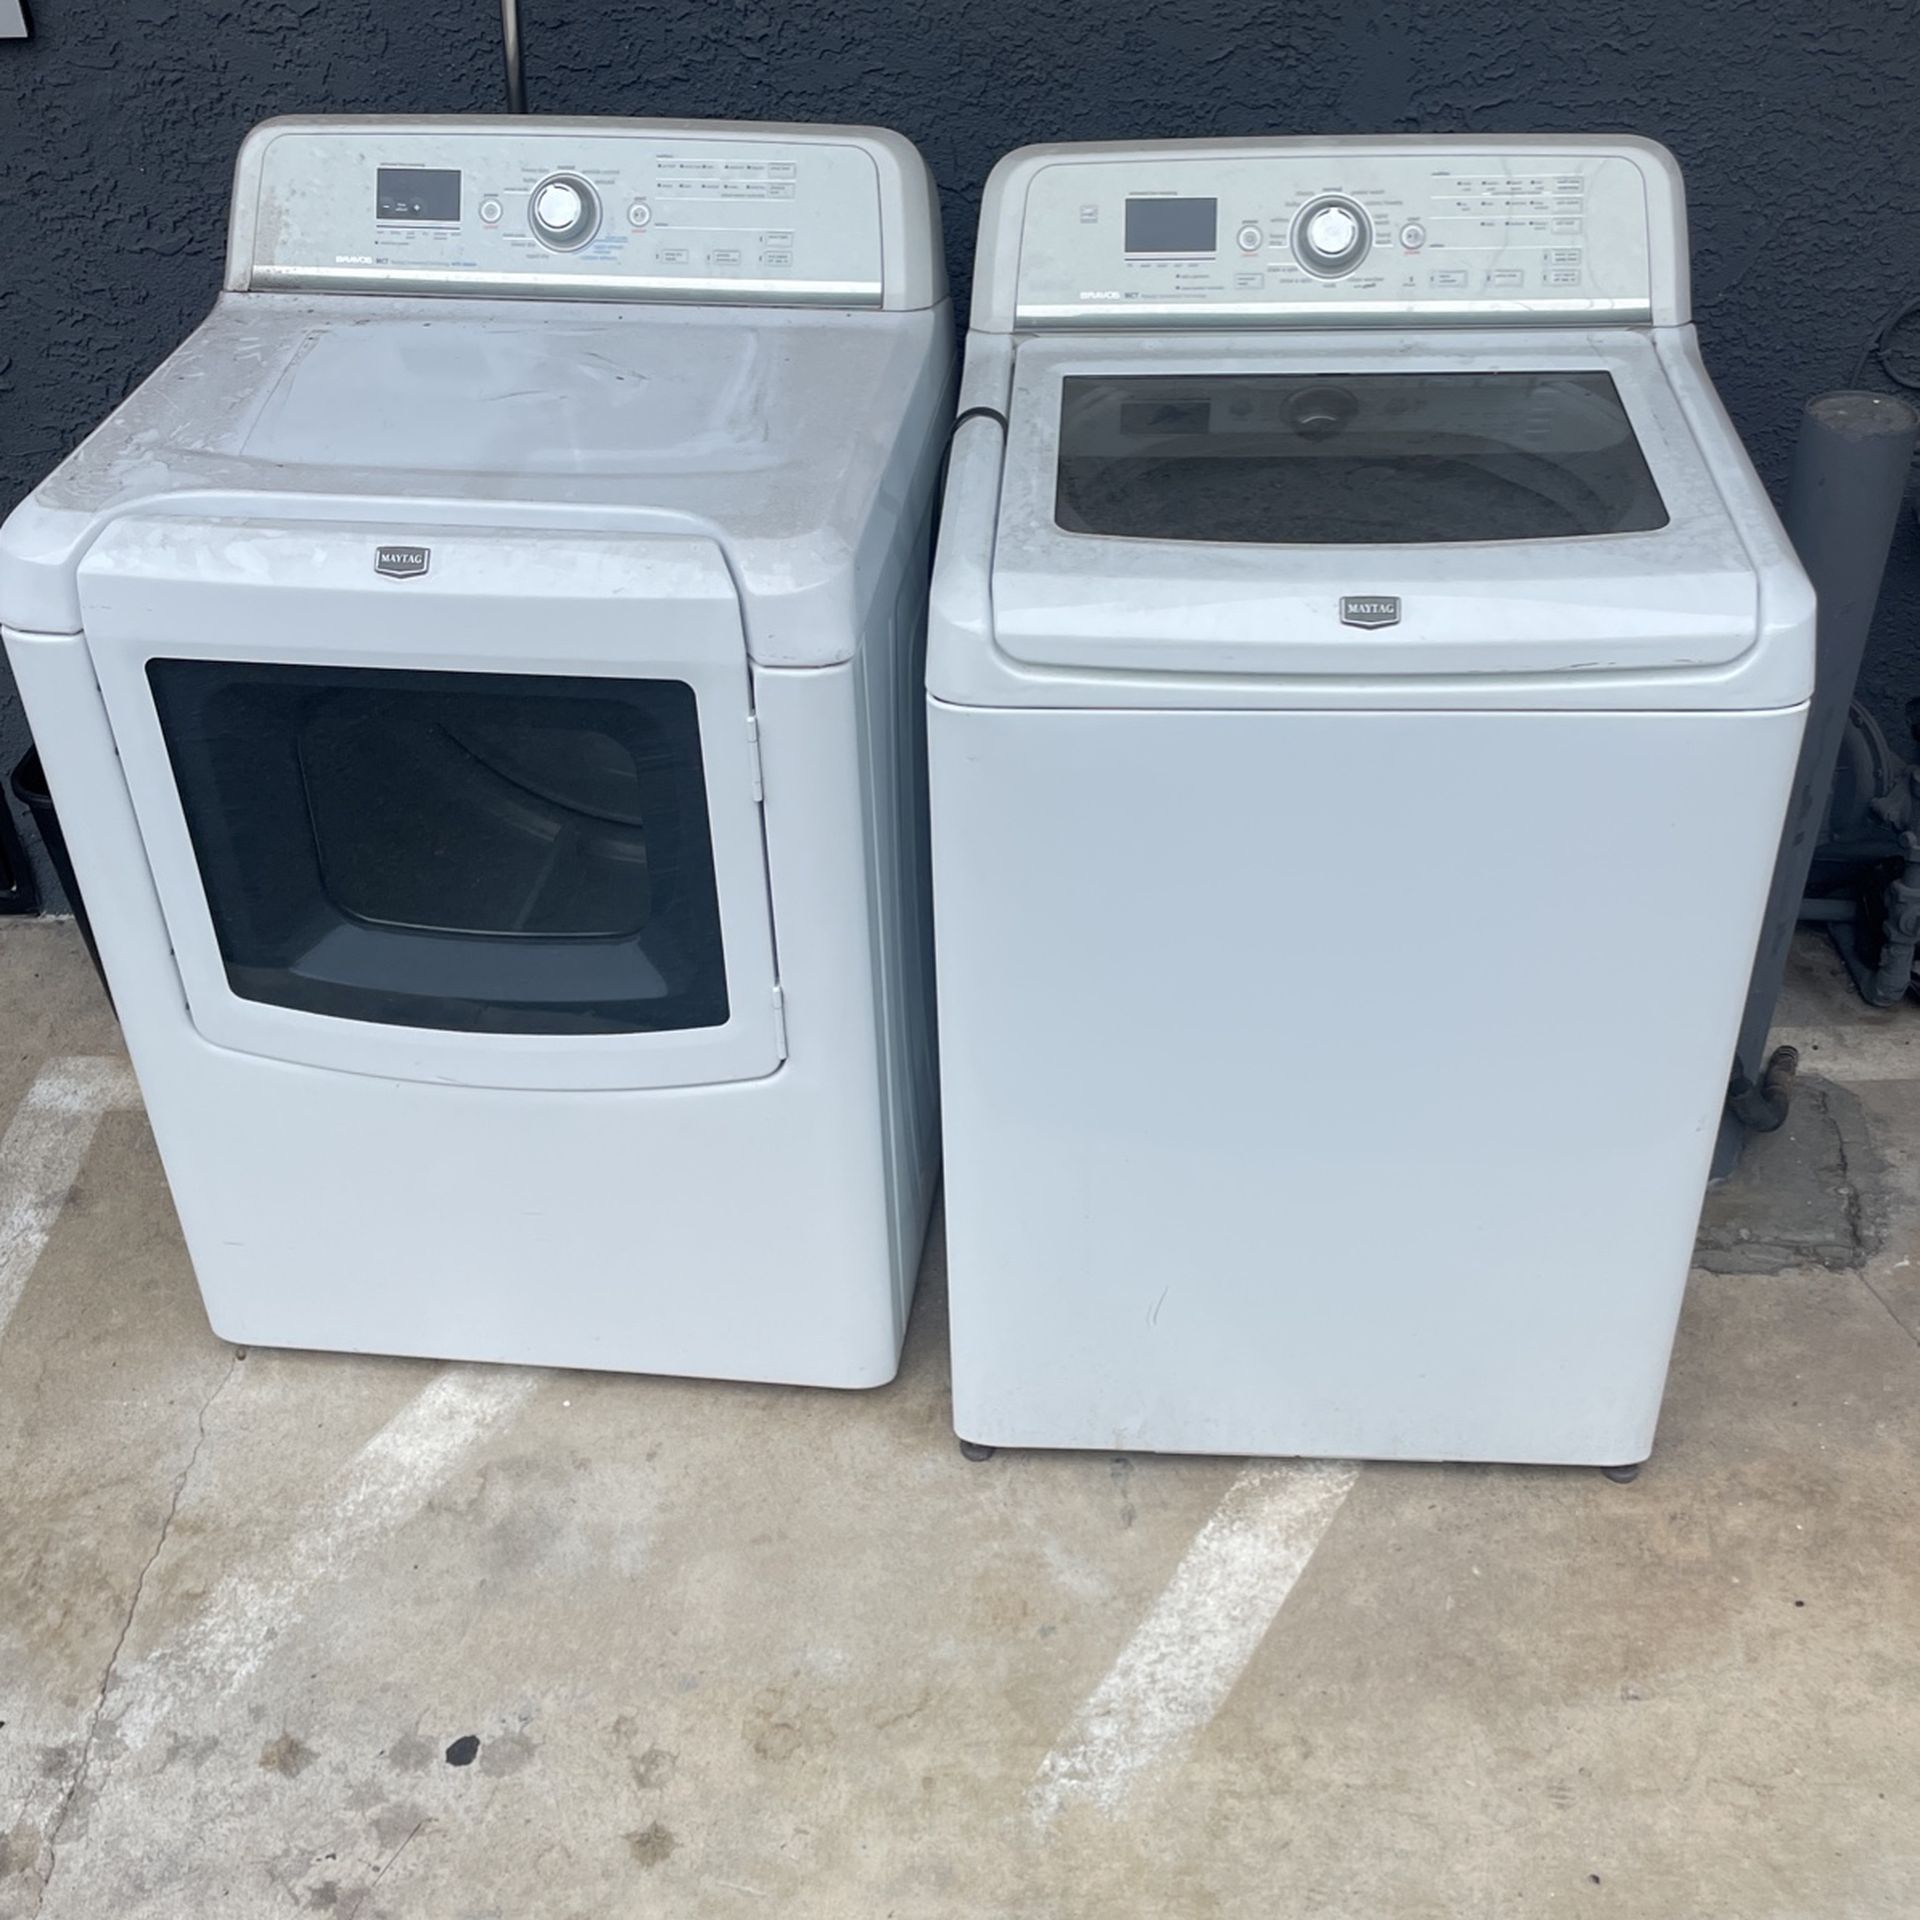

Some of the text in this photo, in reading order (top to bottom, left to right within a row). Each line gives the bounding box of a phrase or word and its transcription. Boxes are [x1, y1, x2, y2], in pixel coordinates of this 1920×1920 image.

[335, 255, 373, 264] BRAVOS
[381, 553, 423, 564] MAYTAG
[1347, 603, 1395, 614] MAYTAG
